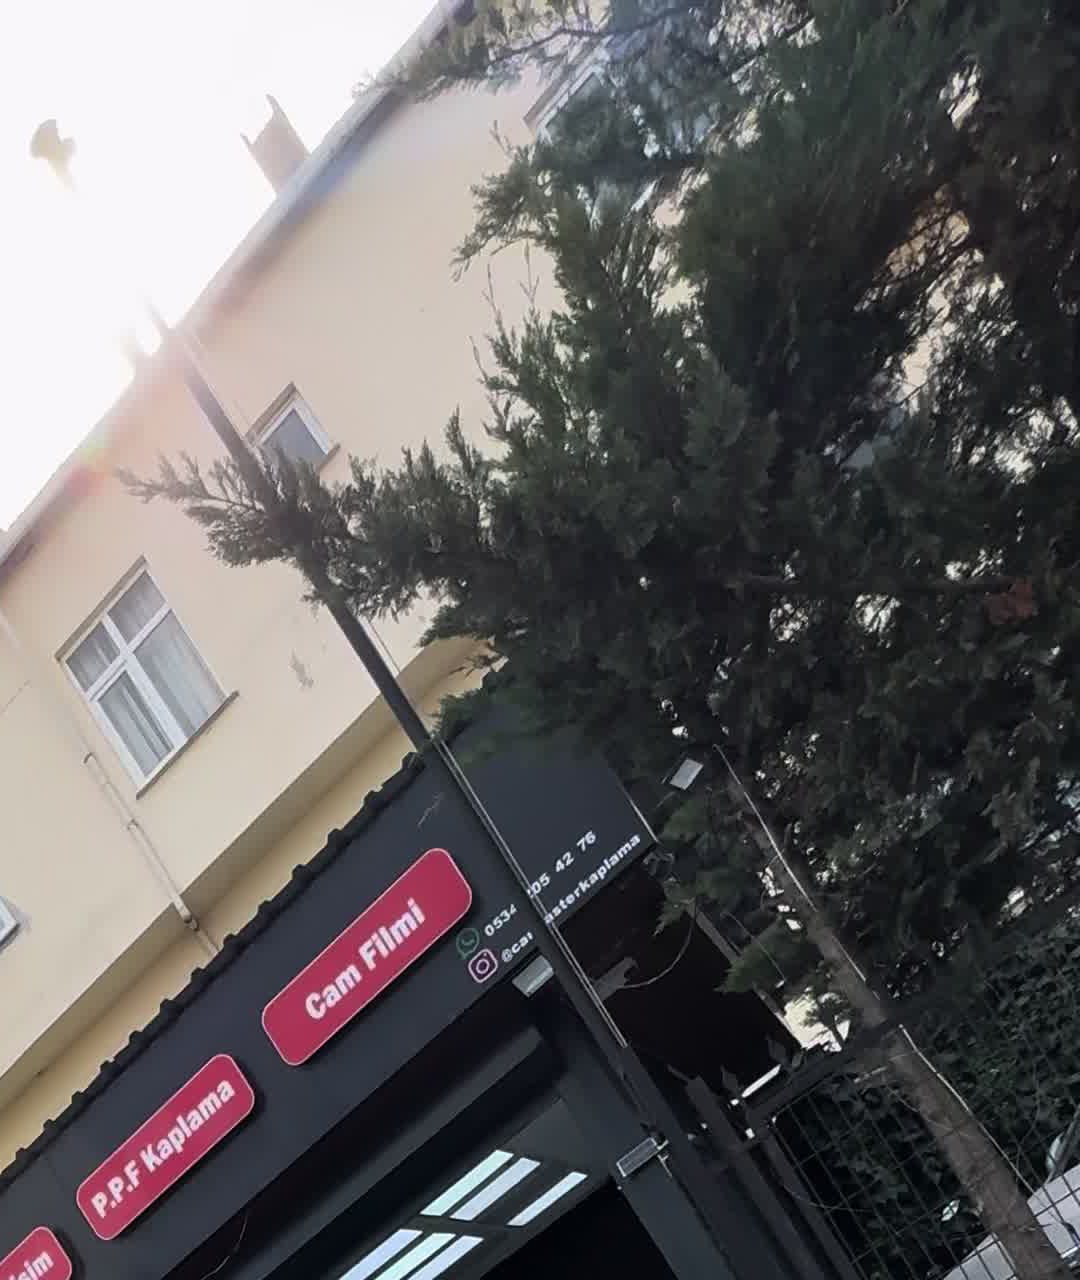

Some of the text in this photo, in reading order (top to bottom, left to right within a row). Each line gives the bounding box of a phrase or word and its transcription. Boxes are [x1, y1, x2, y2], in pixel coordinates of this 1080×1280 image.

[484, 830, 596, 937] 0534 05 42 76
[305, 897, 427, 1020] Cam Filmi
[91, 1079, 235, 1219] P.P.F Kaplama
